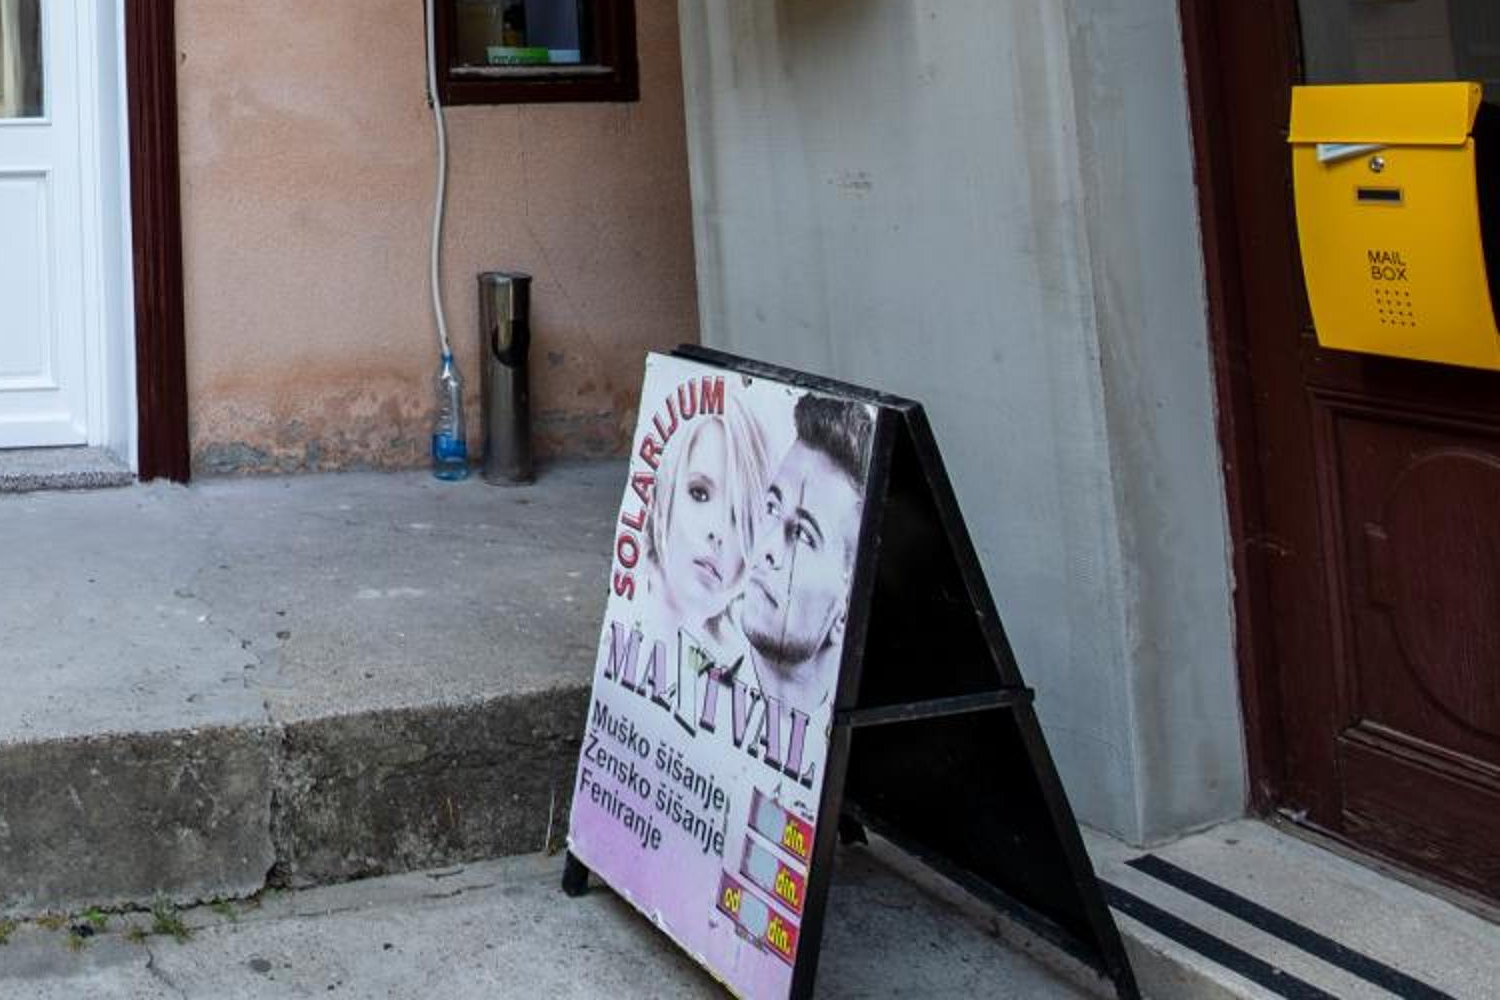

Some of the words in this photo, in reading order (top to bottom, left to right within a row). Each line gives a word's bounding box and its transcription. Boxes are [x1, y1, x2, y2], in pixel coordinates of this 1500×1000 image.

[1368, 249, 1406, 266] MAIL
[1372, 265, 1408, 281] BOX
[614, 376, 725, 600] SOLARIJUM
[592, 700, 651, 759] Muško
[579, 768, 662, 850] Feniranje
[584, 729, 651, 798] Žensko
[655, 783, 725, 857] šišanje
[724, 887, 741, 913] od
